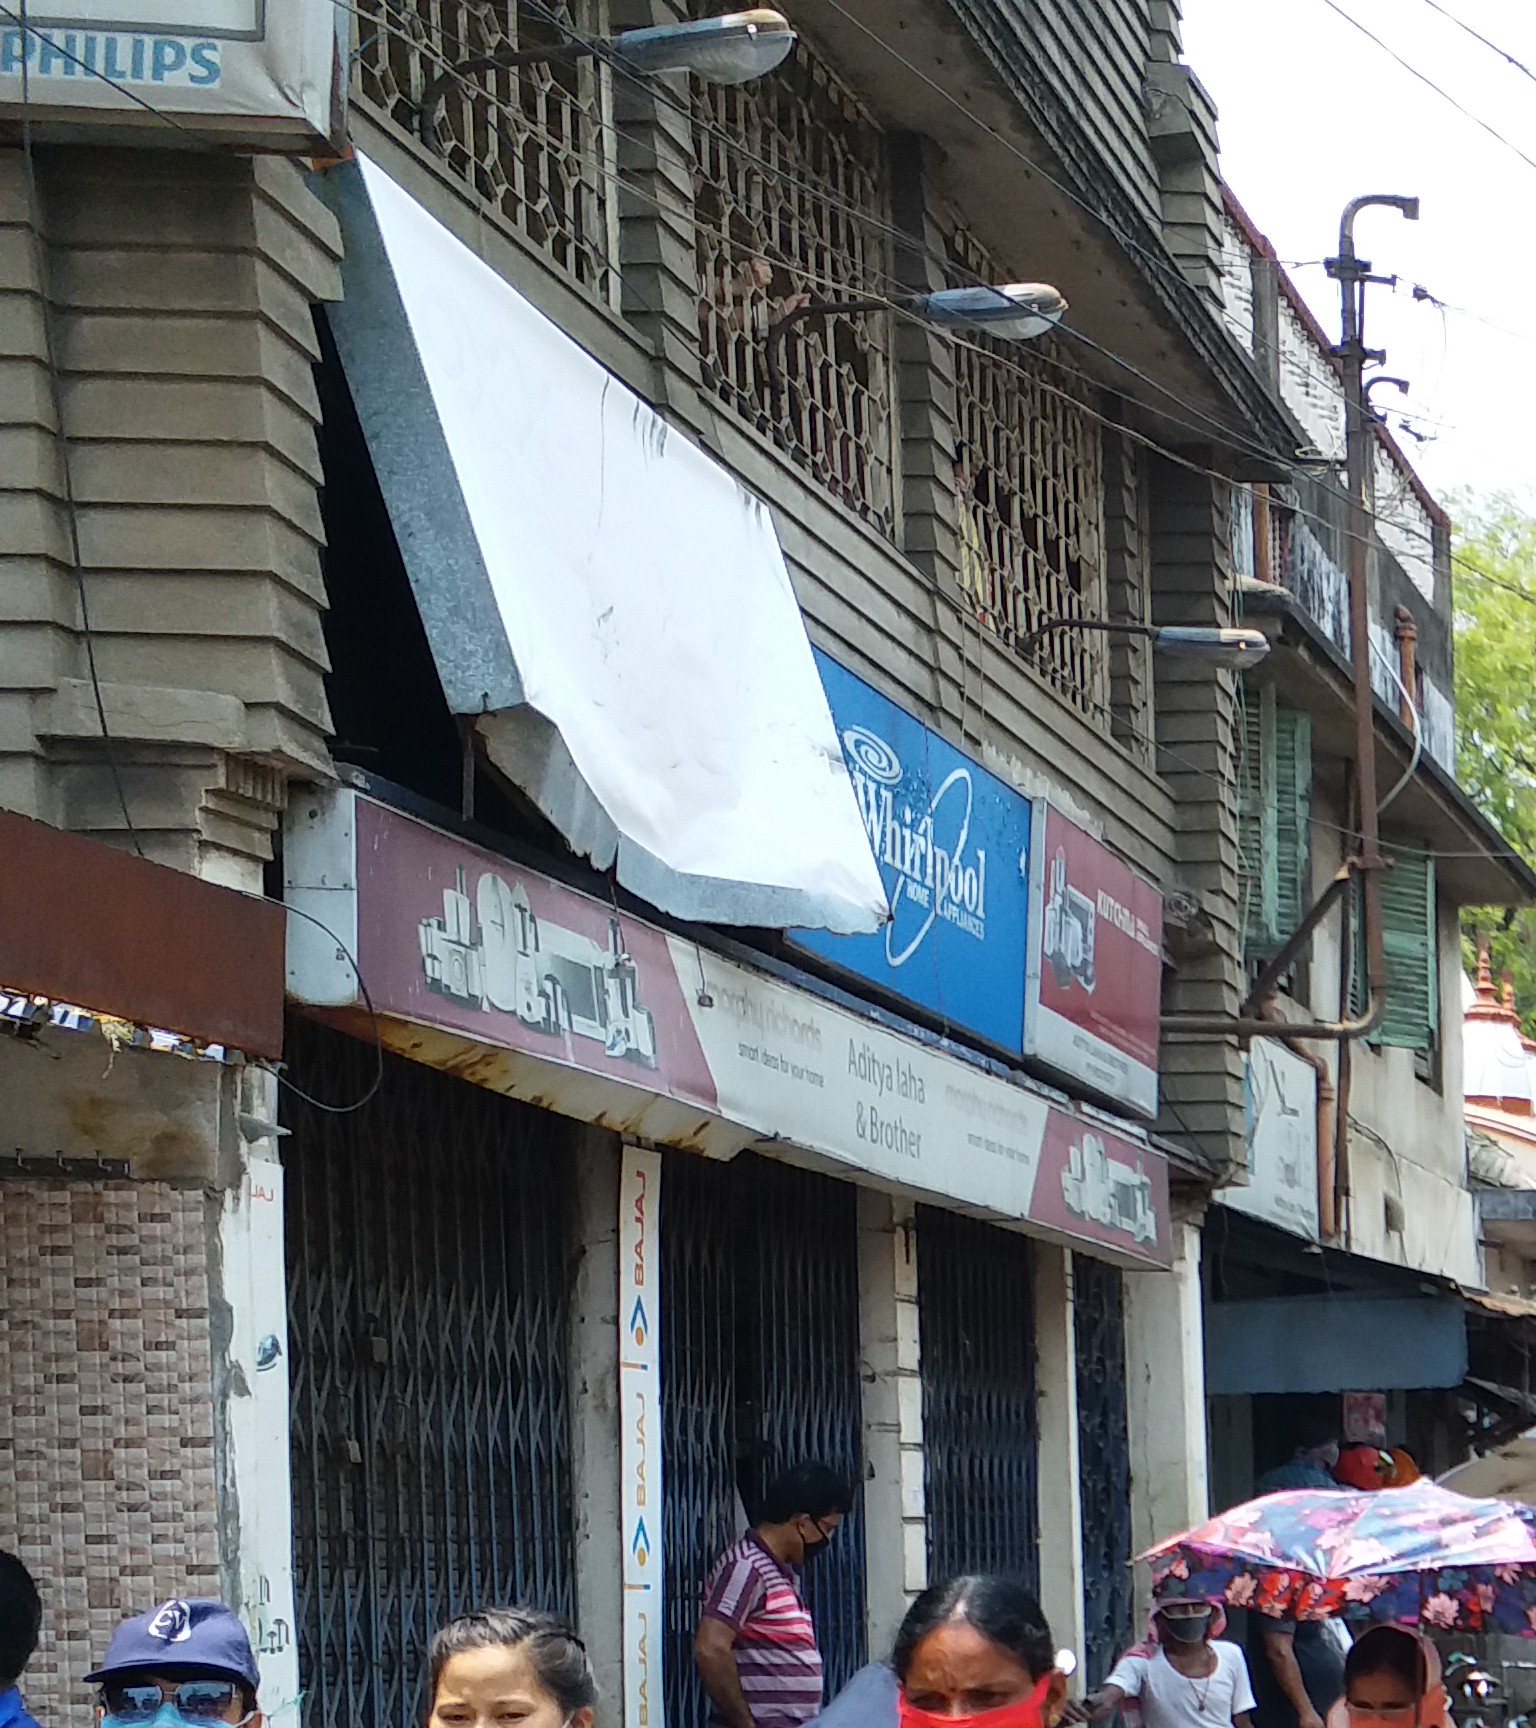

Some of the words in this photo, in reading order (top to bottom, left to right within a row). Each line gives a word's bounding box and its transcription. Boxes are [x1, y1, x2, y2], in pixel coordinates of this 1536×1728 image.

[1, 28, 221, 86] PHILIPS
[852, 768, 986, 920] Whirlpool
[906, 877, 931, 909] HOME
[943, 902, 985, 941] APPLIANCES
[805, 1063, 825, 1088] home
[848, 1037, 894, 1097] Aditya
[896, 1056, 926, 1104] laha
[856, 1100, 868, 1140] &
[869, 1105, 923, 1159] Brother
[634, 1169, 646, 1287] BAJAJ
[635, 1392, 646, 1507] BAJAJ
[638, 1612, 649, 1727] BAJAJ
